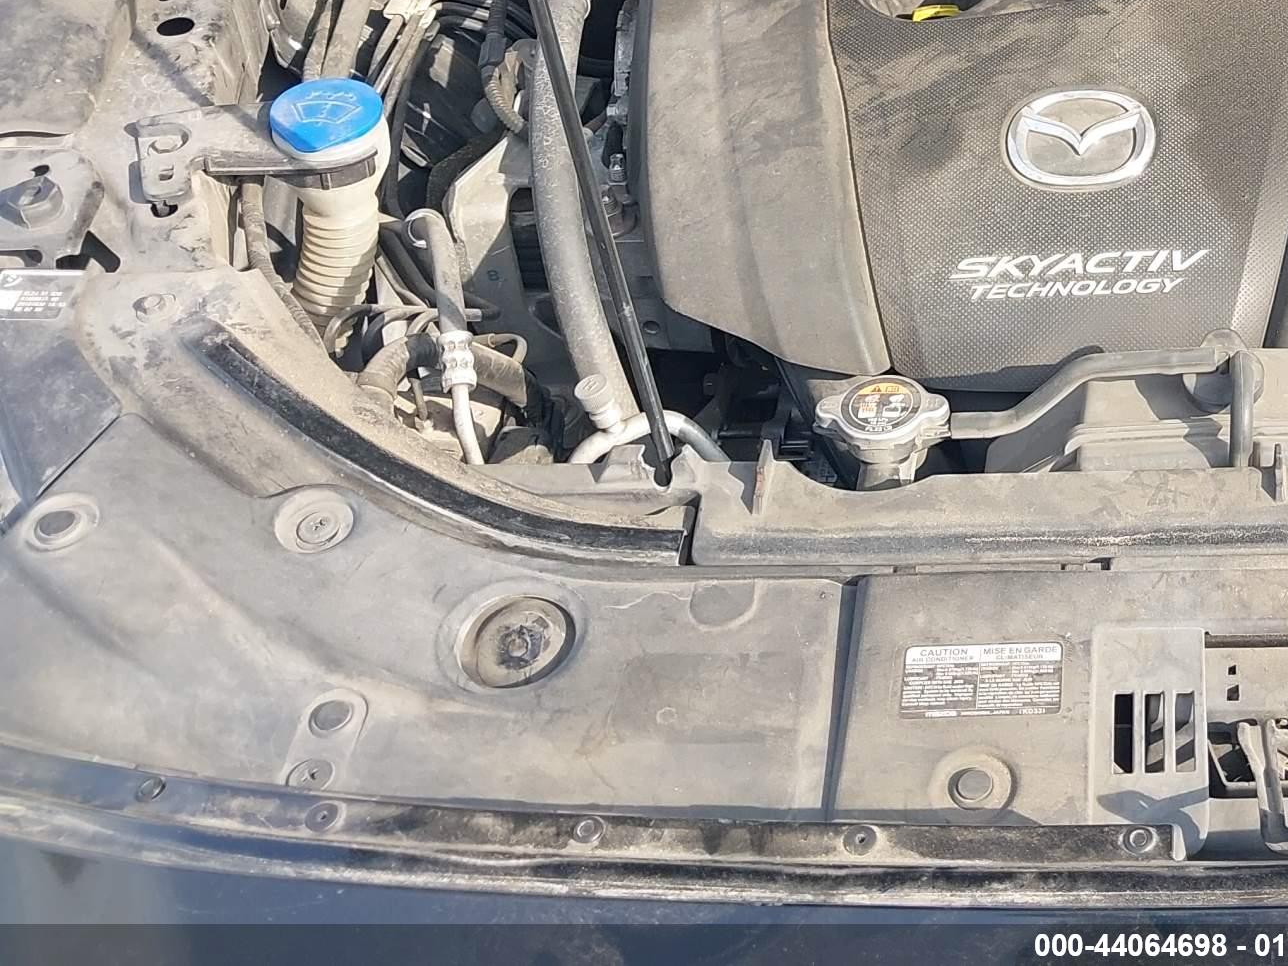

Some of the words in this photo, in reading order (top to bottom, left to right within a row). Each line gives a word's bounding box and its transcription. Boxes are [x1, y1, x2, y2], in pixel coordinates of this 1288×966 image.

[946, 248, 1210, 281] SKYACTIV
[968, 277, 1185, 300] TECHNOLOGY
[1008, 646, 1022, 654] EN
